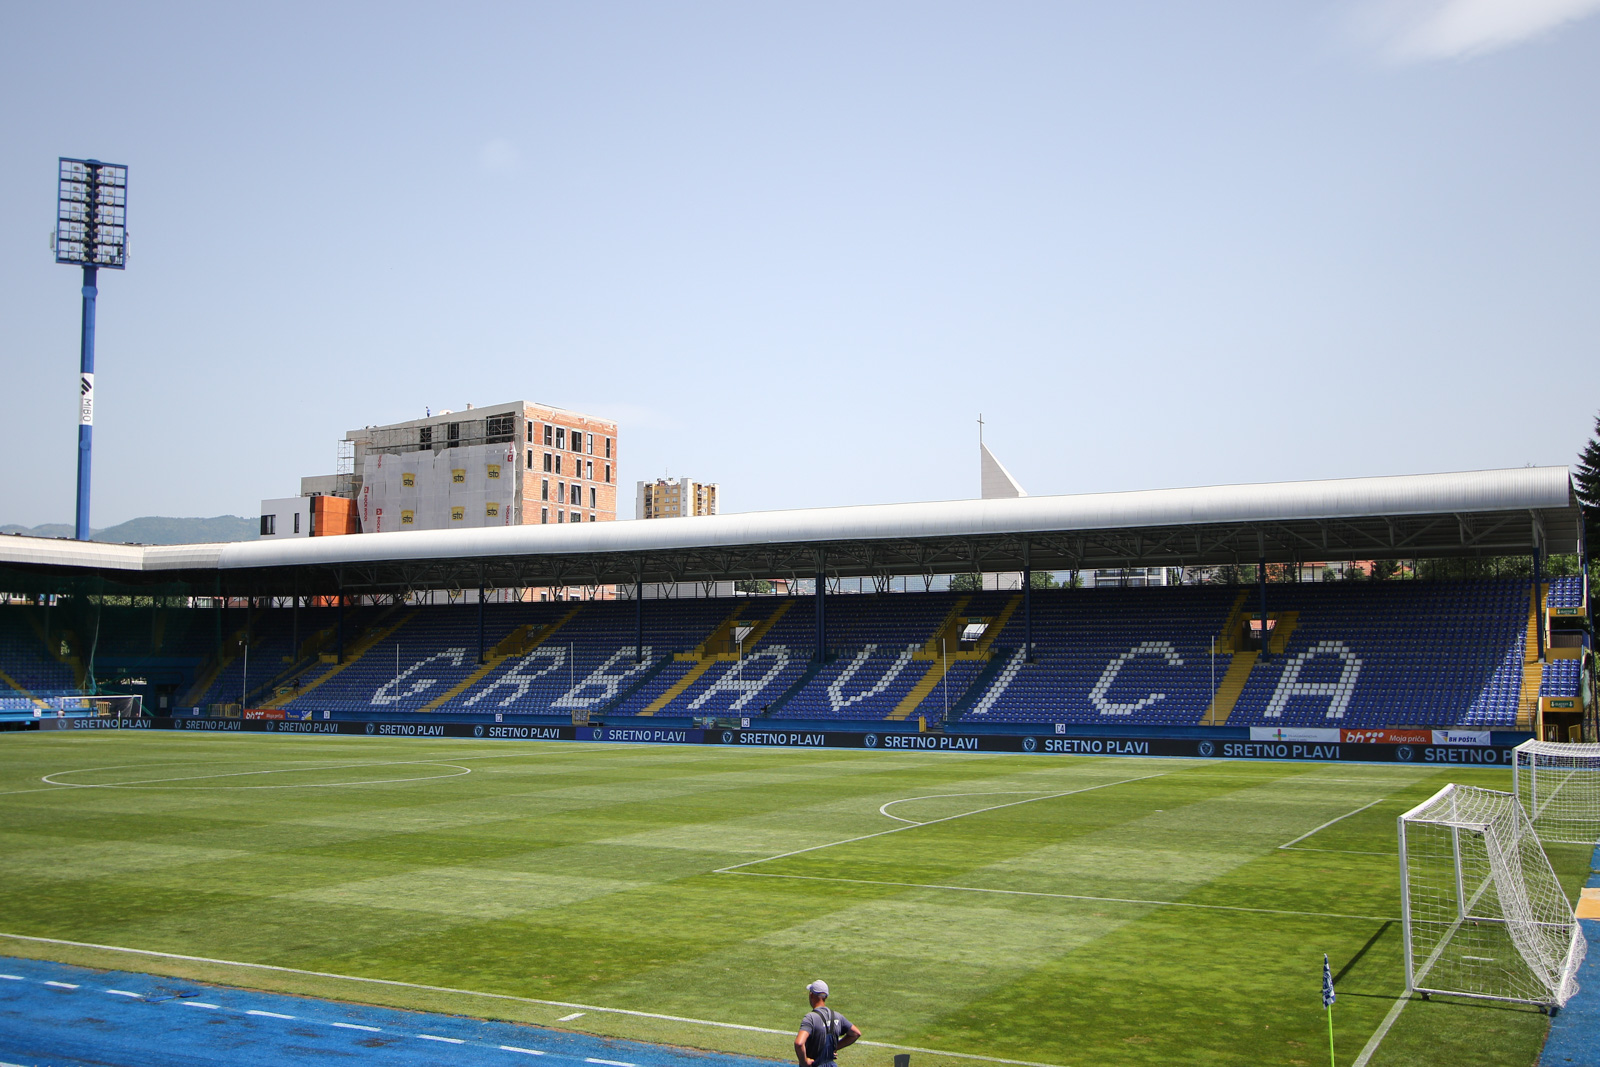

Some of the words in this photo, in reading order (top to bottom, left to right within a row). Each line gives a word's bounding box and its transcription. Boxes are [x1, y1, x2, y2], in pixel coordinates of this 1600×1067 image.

[83, 398, 92, 422] MIBO
[74, 719, 119, 729] SRETNO
[121, 720, 151, 728] PLAVI
[186, 720, 217, 730] SRETNO
[218, 721, 241, 730] PLAVI
[279, 722, 312, 732] SRETNO
[313, 723, 338, 733] PLAVI
[379, 724, 415, 735] SRETNO
[417, 725, 444, 736] PLAVI
[489, 727, 528, 738] SRETNO
[530, 728, 560, 739] PLAVI
[608, 729, 650, 741] SRETNO
[654, 730, 686, 742] PLAVI
[739, 732, 786, 744] SRETNO
[789, 733, 824, 746] PLAVI
[1345, 731, 1365, 743] bh
[1389, 734, 1406, 743] Moja
[1458, 735, 1477, 743] POŠTA
[884, 736, 936, 749] SRETNO
[939, 737, 978, 750] PLAVI
[1044, 739, 1102, 753] SRETNO
[1106, 741, 1149, 754] PLAVI
[1223, 743, 1288, 757] SRETNO
[1293, 745, 1340, 759] PLAVI
[1424, 748, 1497, 763] SRETNO
